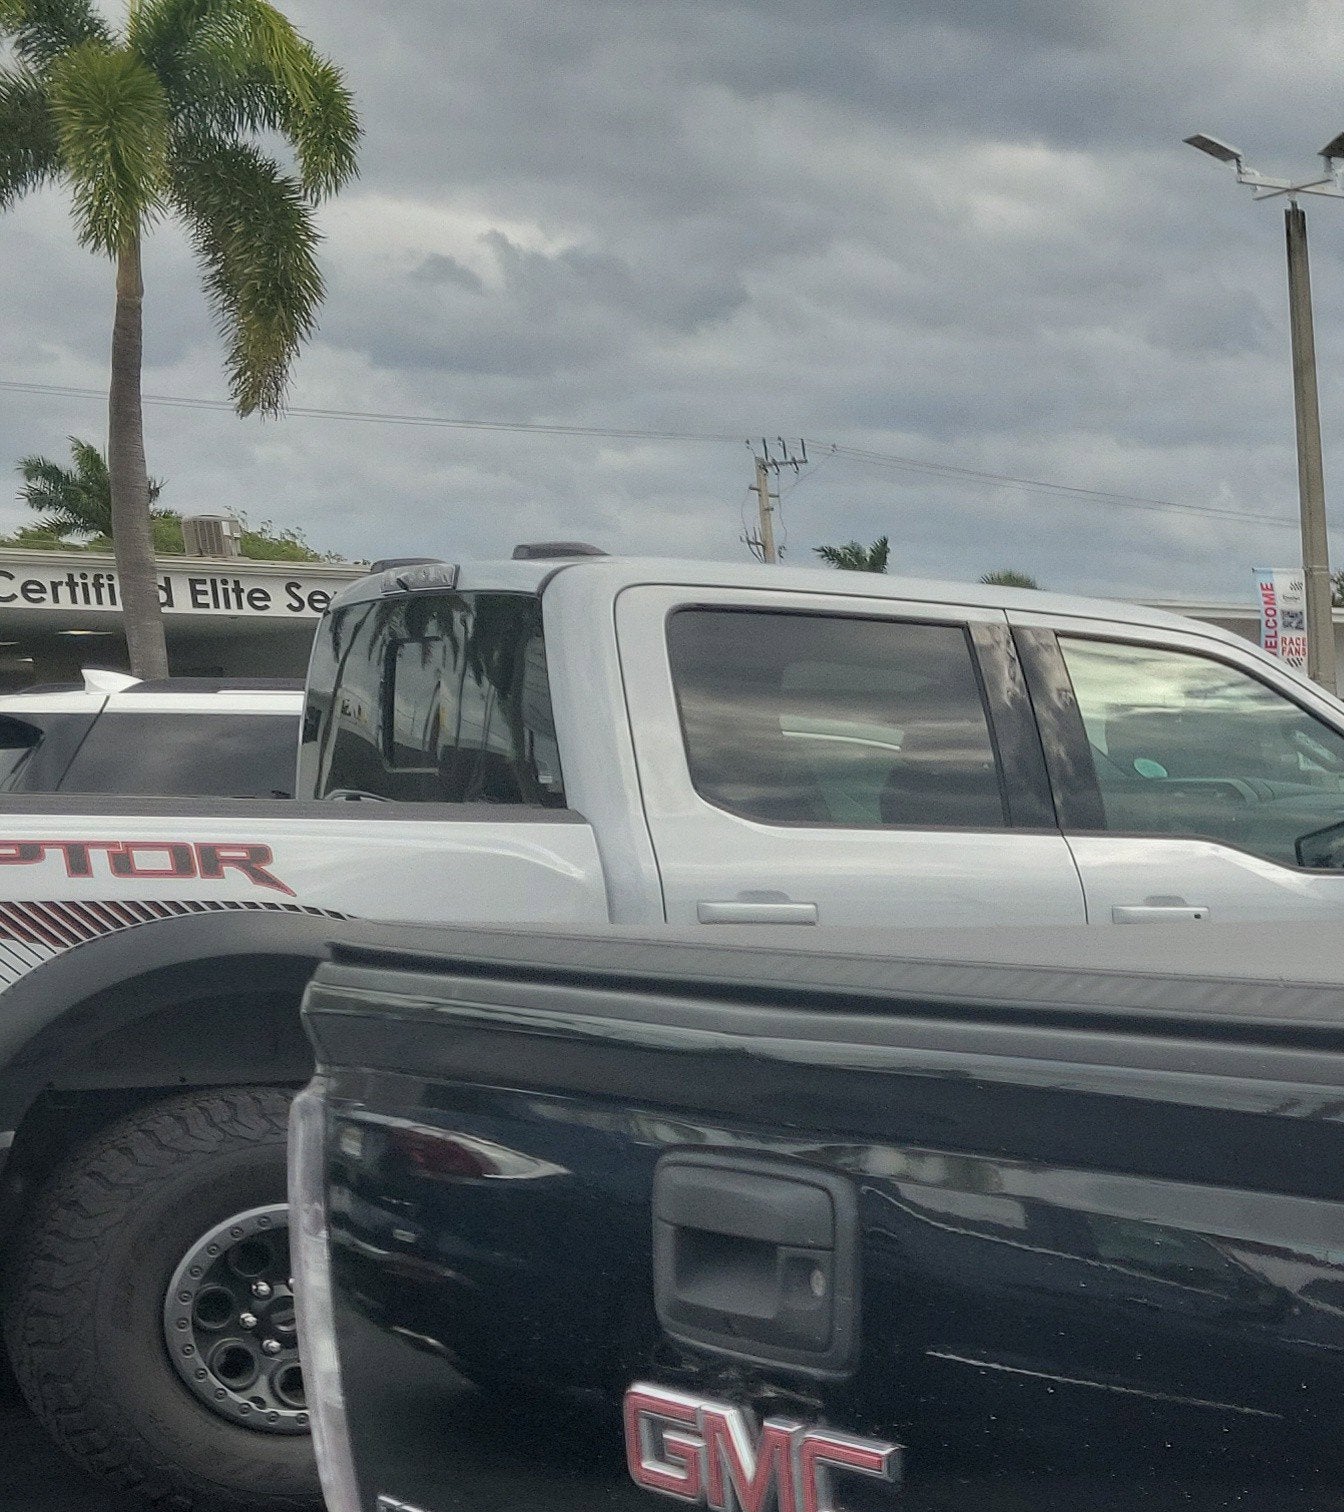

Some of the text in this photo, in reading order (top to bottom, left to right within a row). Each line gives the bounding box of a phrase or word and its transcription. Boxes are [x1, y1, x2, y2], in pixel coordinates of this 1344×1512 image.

[0, 570, 336, 613] Certifid Elite Se
[1260, 582, 1277, 655] ELCOME
[1281, 637, 1307, 646] RACE
[1281, 648, 1307, 656] FANS
